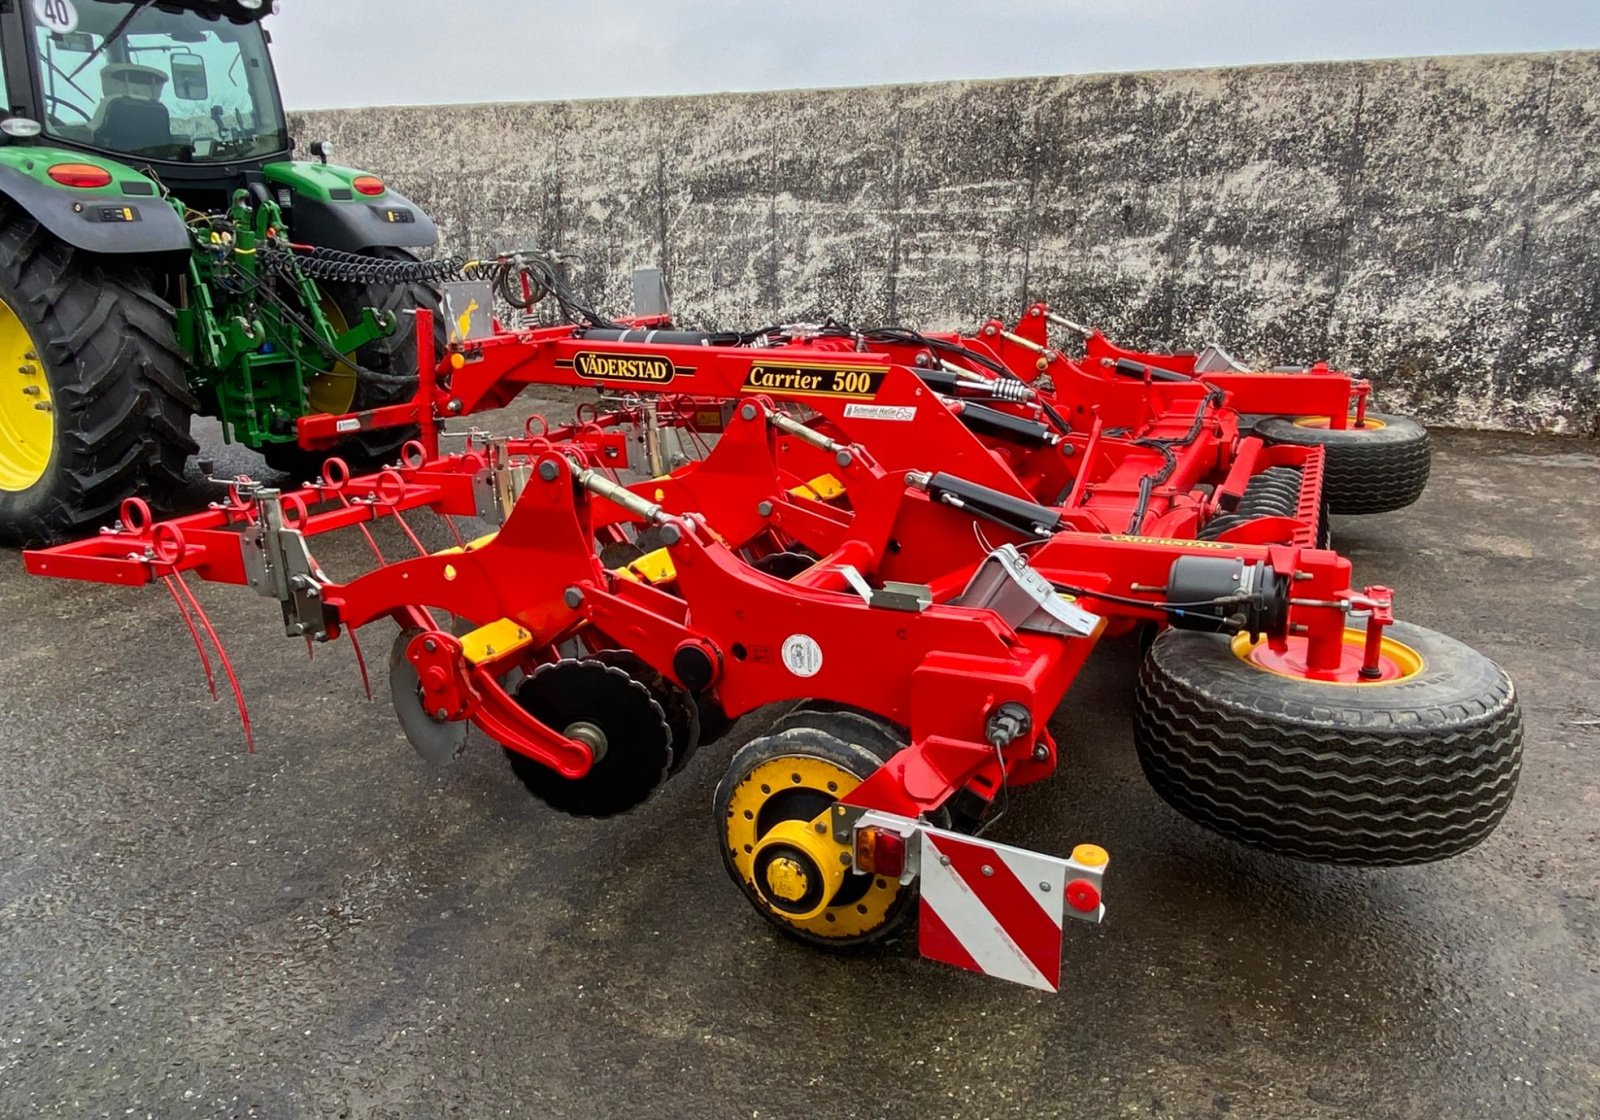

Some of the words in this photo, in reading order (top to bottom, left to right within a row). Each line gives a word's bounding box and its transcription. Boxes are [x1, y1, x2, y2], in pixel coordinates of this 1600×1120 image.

[45, 0, 69, 26] 40
[579, 353, 667, 379] VÄDERSTAD
[750, 367, 822, 389] Carrier
[832, 371, 870, 393] 500
